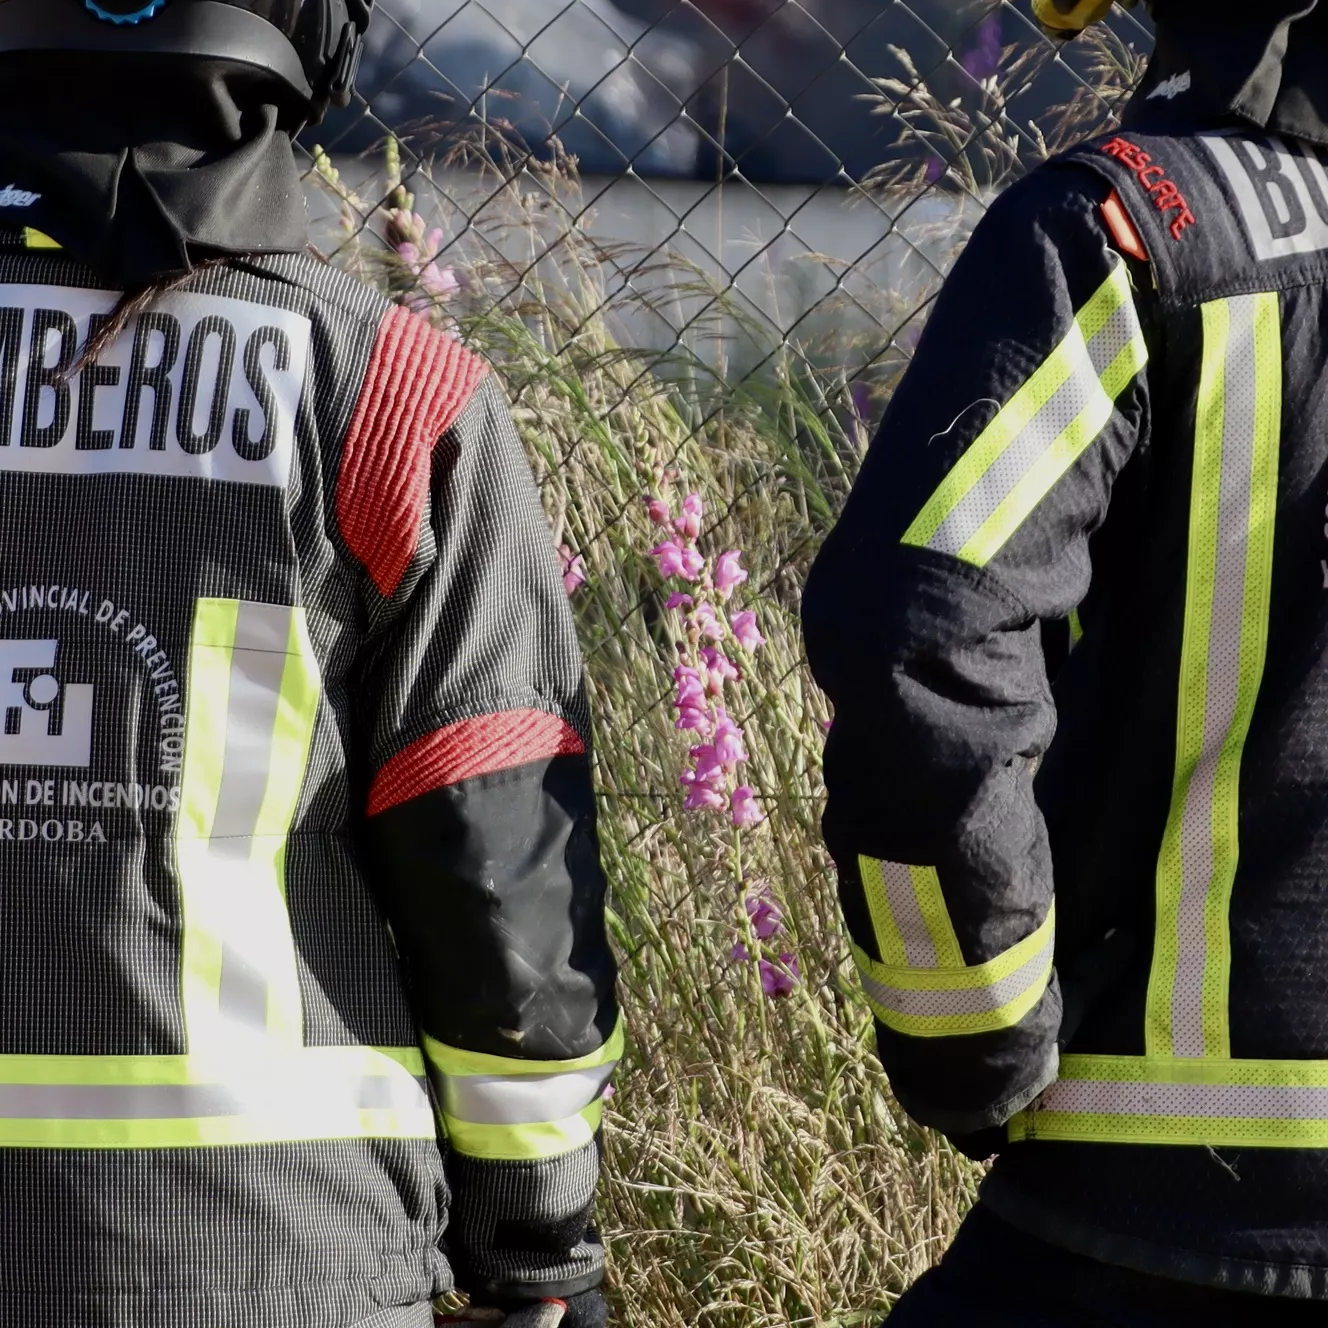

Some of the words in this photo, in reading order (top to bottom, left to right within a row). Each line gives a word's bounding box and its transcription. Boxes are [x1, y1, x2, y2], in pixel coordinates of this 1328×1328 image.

[1100, 136, 1196, 240] RESCATE
[95, 599, 131, 632] DE
[126, 623, 185, 773] PREVENCION
[26, 780, 54, 806] DE
[63, 780, 181, 812] INCENDIOS
